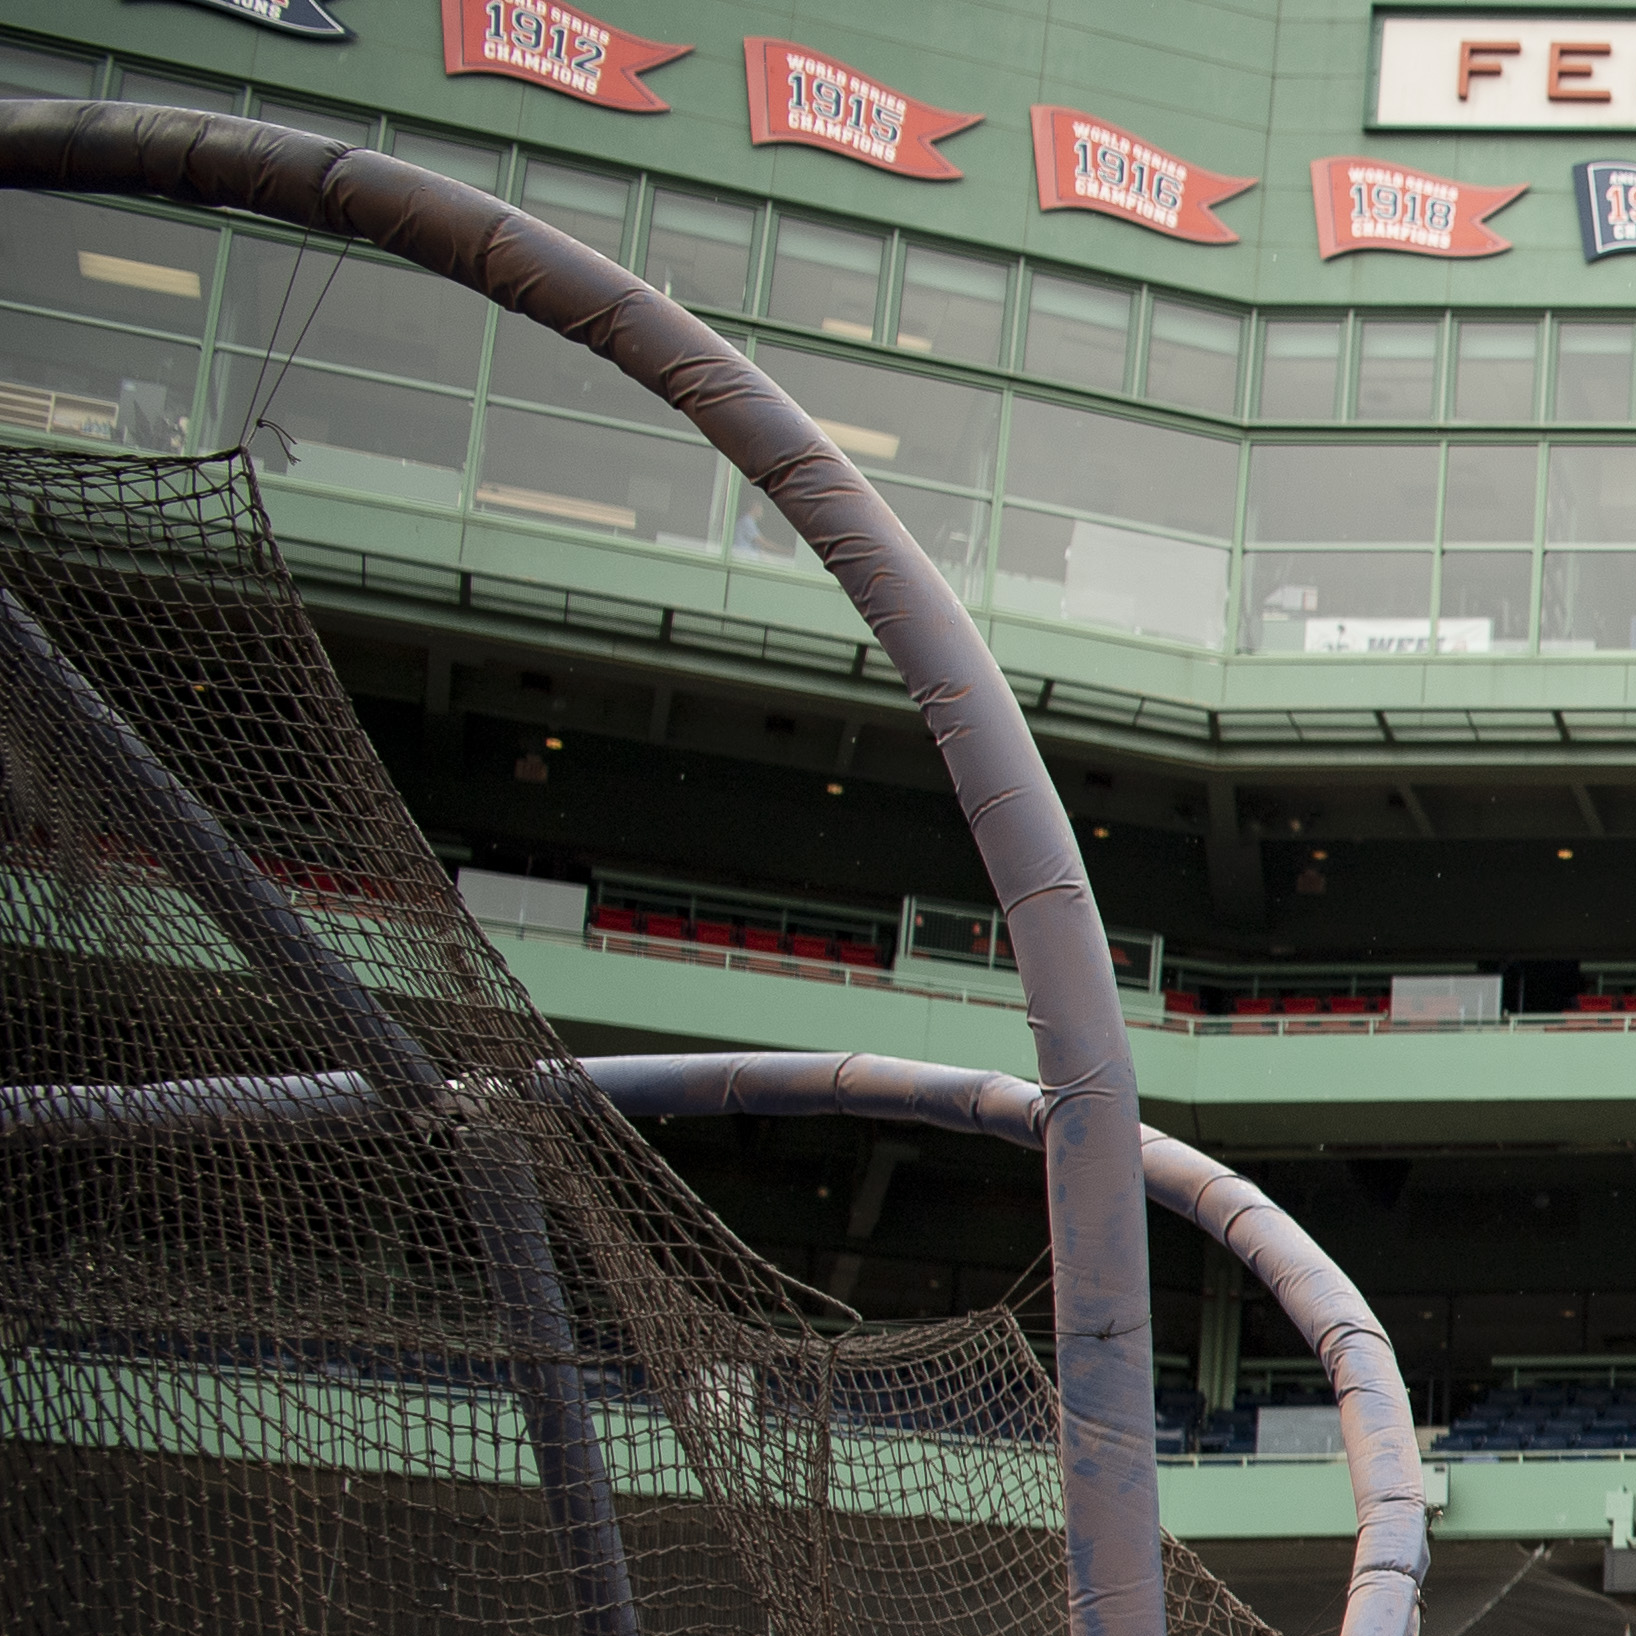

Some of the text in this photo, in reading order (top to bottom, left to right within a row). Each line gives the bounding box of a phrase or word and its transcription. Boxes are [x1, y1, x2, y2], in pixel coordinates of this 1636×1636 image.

[485, 0, 606, 77] 1912
[550, 6, 610, 46] SERIES
[484, 41, 598, 95] CHAMPIONS
[786, 53, 907, 113] WORLD SERIES
[788, 71, 902, 144] 1915
[788, 111, 897, 162] CHAMPIONS
[1073, 121, 1187, 179] WORLD SERIES
[1073, 138, 1185, 210] 1916
[1074, 179, 1178, 229] CHAMPIONS
[1349, 181, 1457, 232] 1918
[1351, 218, 1451, 249] CHAMPIONS
